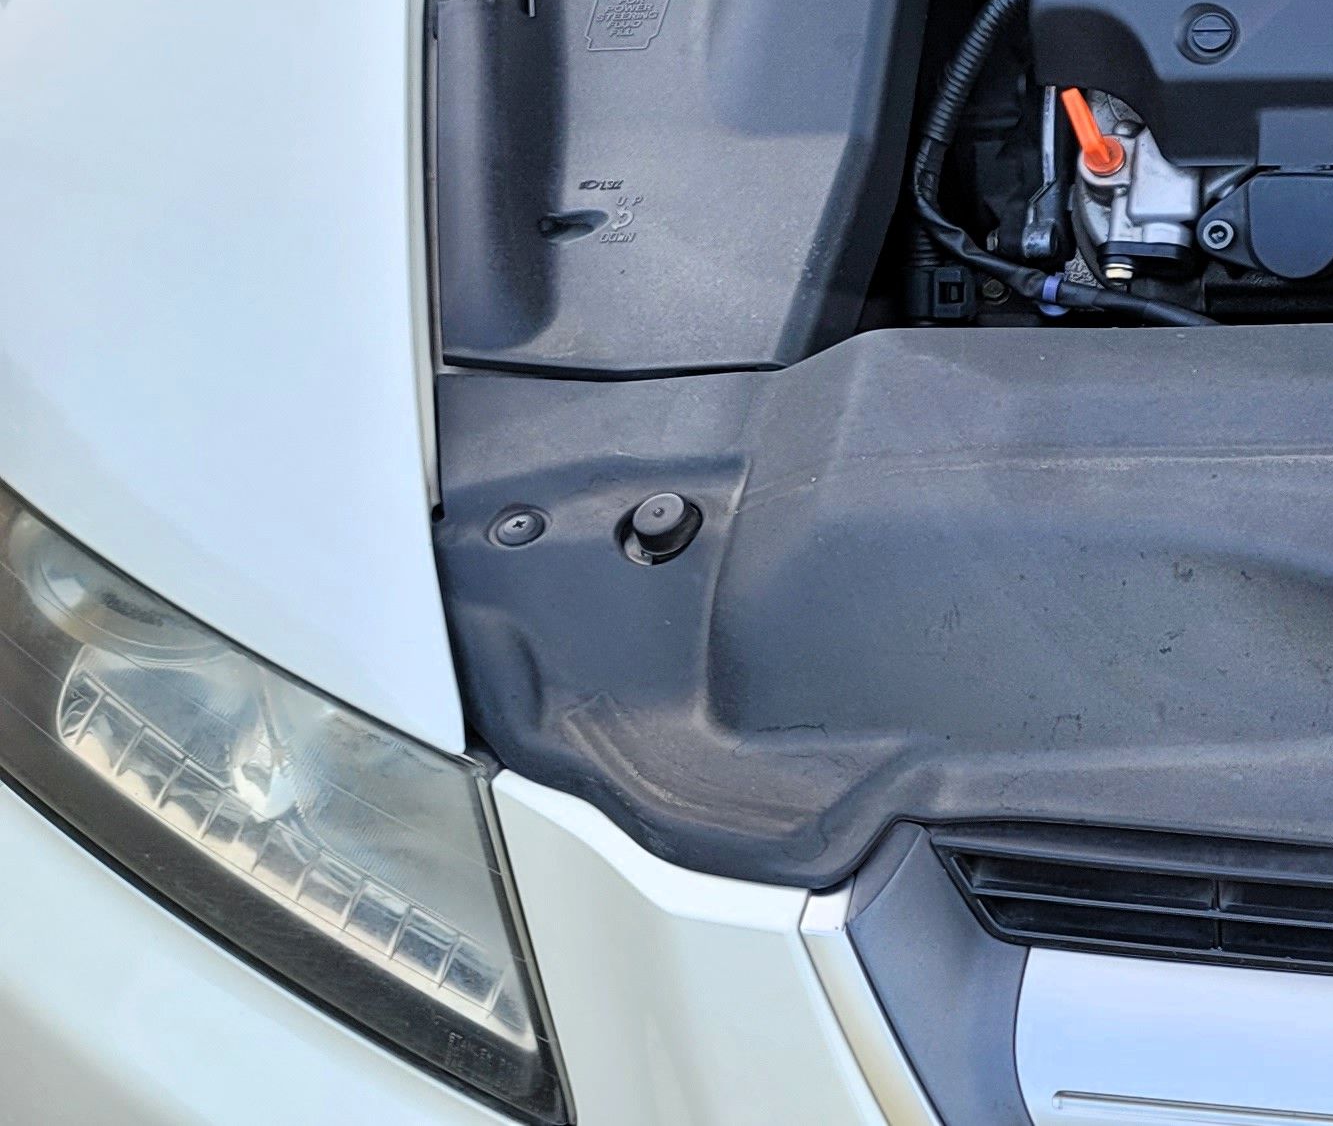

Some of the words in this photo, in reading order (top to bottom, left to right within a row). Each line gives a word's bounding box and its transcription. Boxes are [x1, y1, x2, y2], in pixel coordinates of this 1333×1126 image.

[604, 4, 654, 14] POWER
[596, 11, 659, 23] STEERING
[616, 196, 644, 207] UP
[599, 232, 637, 244] DOWN
